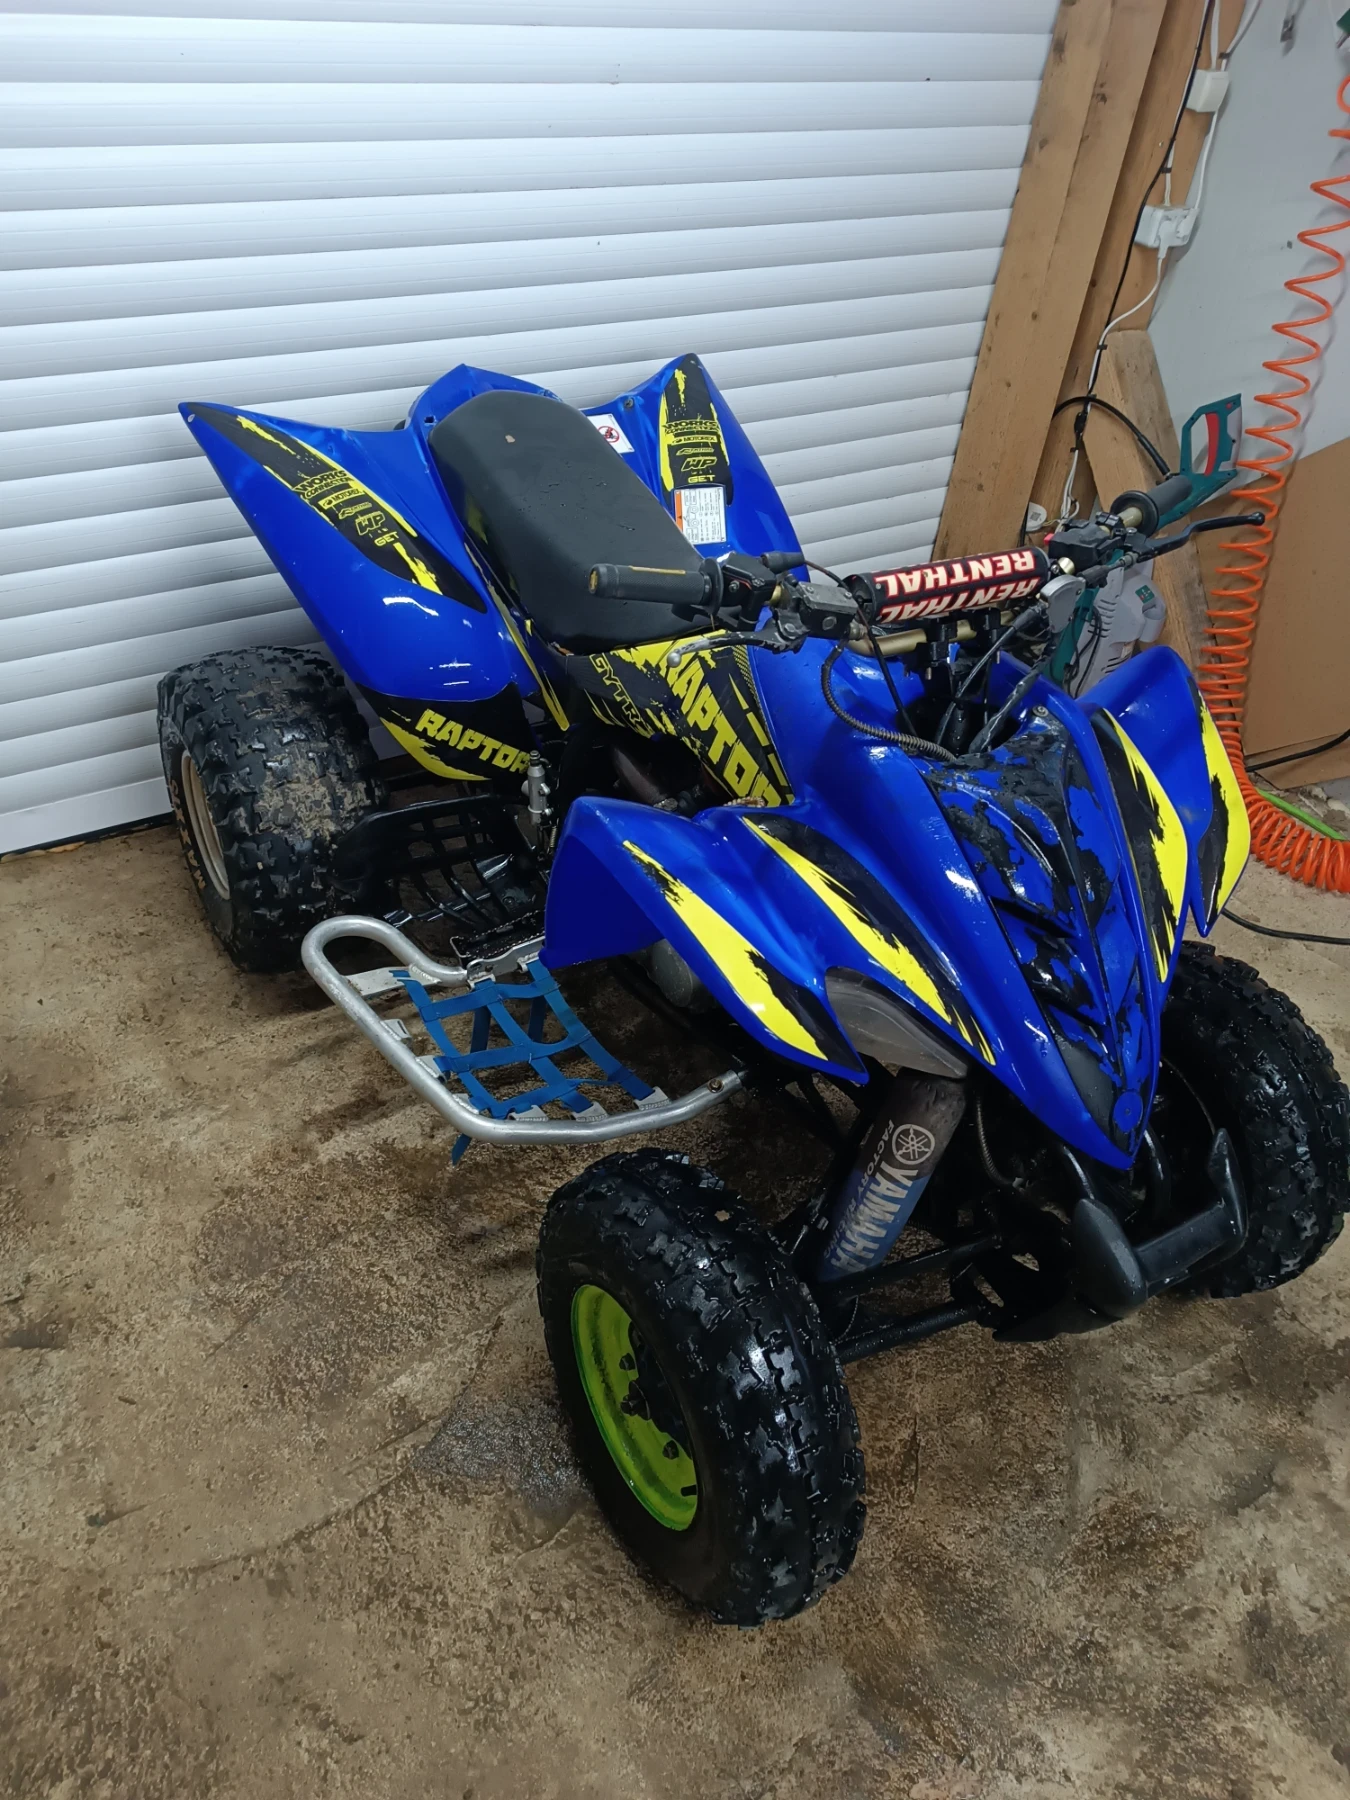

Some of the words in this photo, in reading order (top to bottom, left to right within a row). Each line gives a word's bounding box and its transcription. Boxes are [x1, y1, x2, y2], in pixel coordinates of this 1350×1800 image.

[662, 420, 717, 429] WORKS
[294, 469, 347, 491] WORKS
[681, 456, 717, 471] WP
[688, 475, 716, 483] GET
[355, 511, 386, 536] WP
[374, 531, 399, 546] GET
[875, 550, 1035, 598] RENTHAL
[880, 577, 1040, 623] RENTHAL
[589, 652, 643, 725] GYTR
[415, 708, 531, 774] RAPTOR
[857, 1119, 895, 1198] FACTORY
[830, 1161, 918, 1271] YAMAHA
